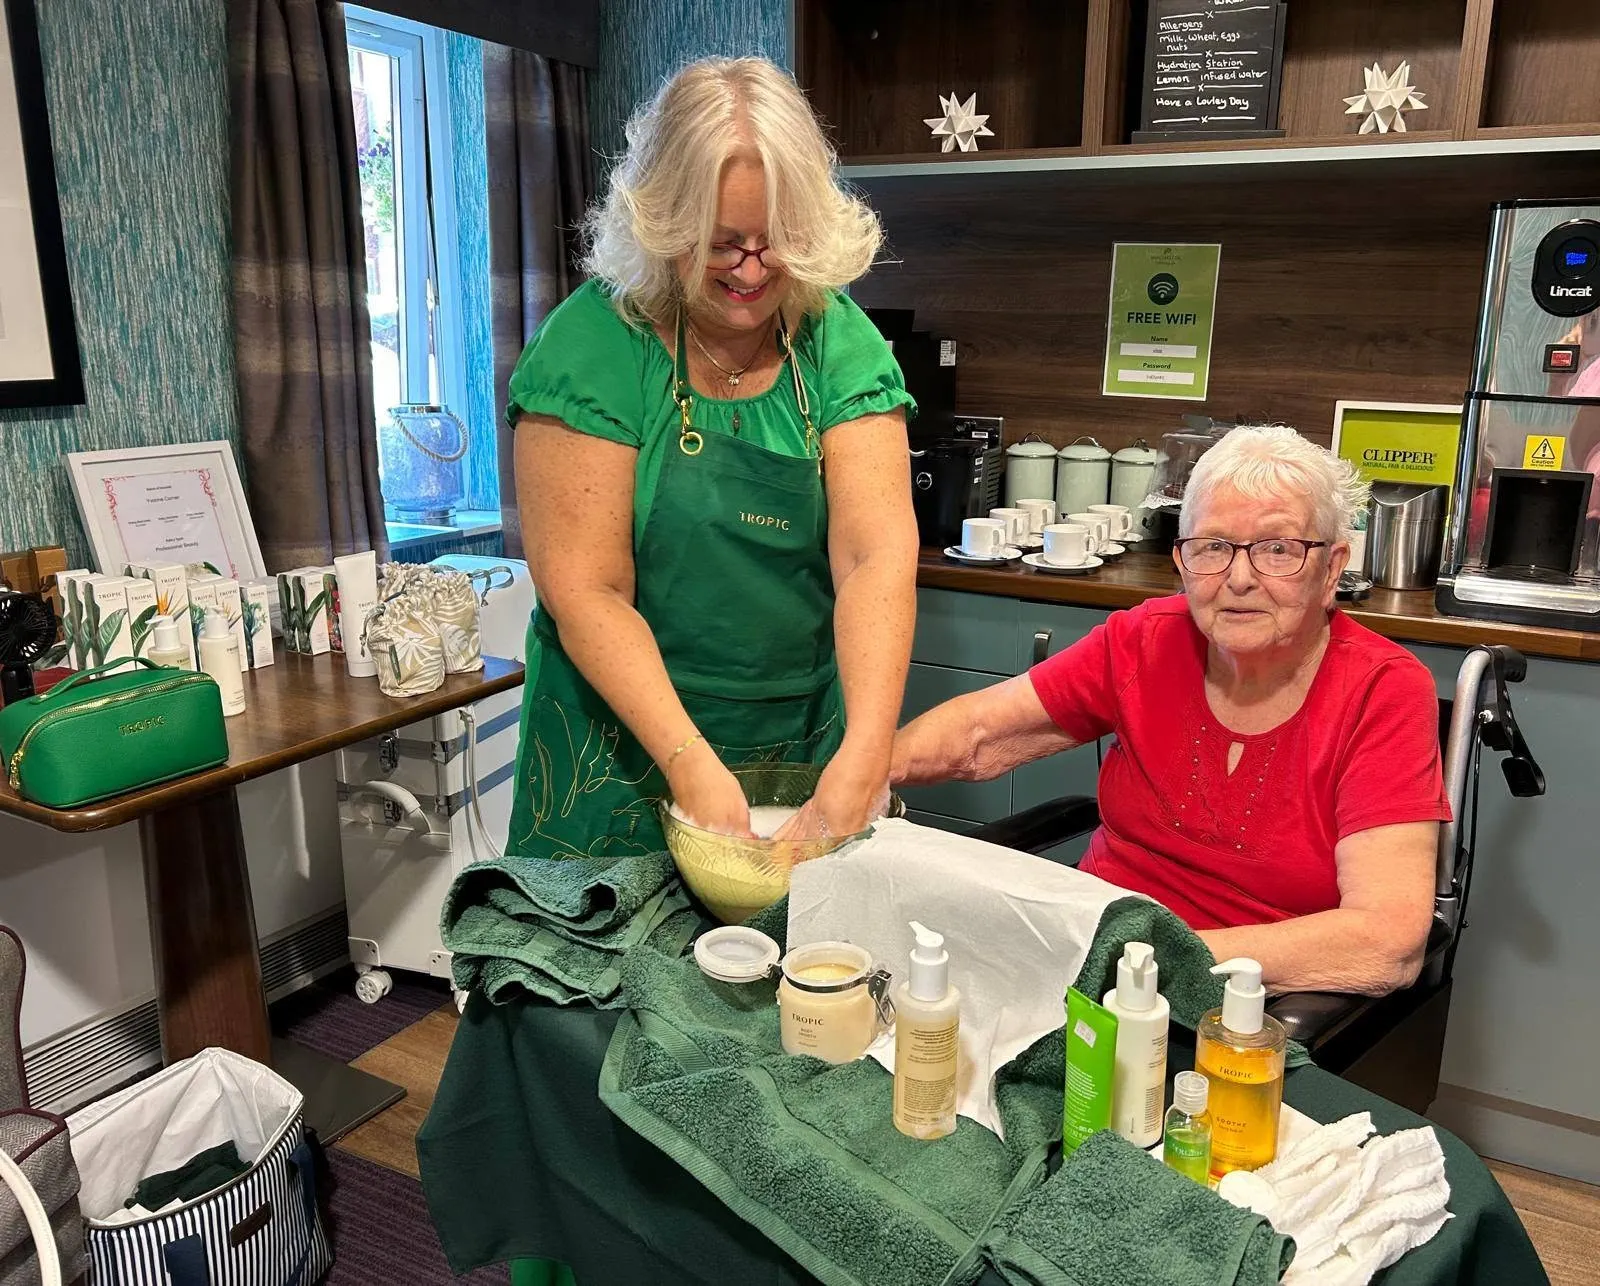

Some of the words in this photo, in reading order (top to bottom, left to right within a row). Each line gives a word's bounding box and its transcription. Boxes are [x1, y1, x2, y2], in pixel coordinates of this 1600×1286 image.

[1160, 21, 1203, 31] Allergens
[1220, 32, 1240, 42] Eggs
[1157, 60, 1202, 71] Hydration
[1206, 58, 1244, 68] Station
[1156, 76, 1190, 84] Lemon
[1200, 71, 1236, 81] infused
[1238, 70, 1268, 78] water
[1156, 98, 1181, 106] Have
[1228, 96, 1250, 110] Day
[1550, 286, 1592, 296] Lincat
[1127, 312, 1162, 324] FREE
[1166, 313, 1197, 325] WIFI
[1363, 448, 1434, 464] CLIPPER
[740, 512, 790, 531] TROPIC
[118, 716, 165, 736] TROPIC
[792, 1013, 824, 1026] TROPIC
[1220, 1066, 1253, 1079] TROPIC
[1216, 1117, 1247, 1127] SOOTHE
